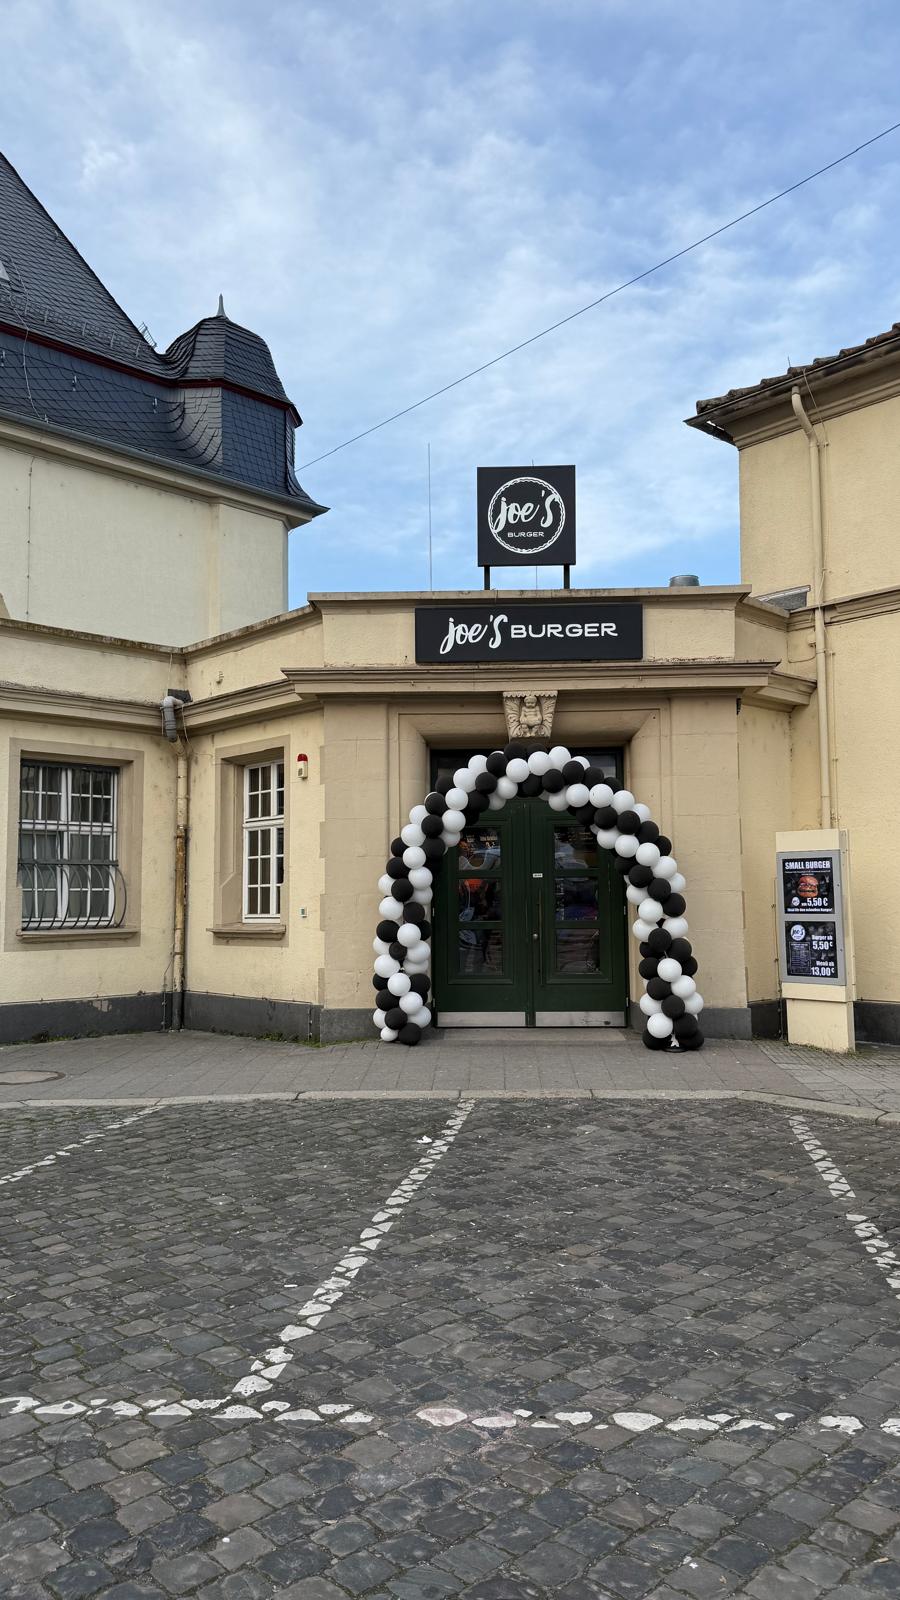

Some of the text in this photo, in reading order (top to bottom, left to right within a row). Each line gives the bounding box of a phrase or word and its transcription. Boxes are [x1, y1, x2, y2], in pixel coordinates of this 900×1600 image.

[510, 622, 618, 638] BURGER
[785, 860, 831, 870] SMALL BURGER
[807, 897, 822, 907] 5,50
[822, 897, 829, 907] €
